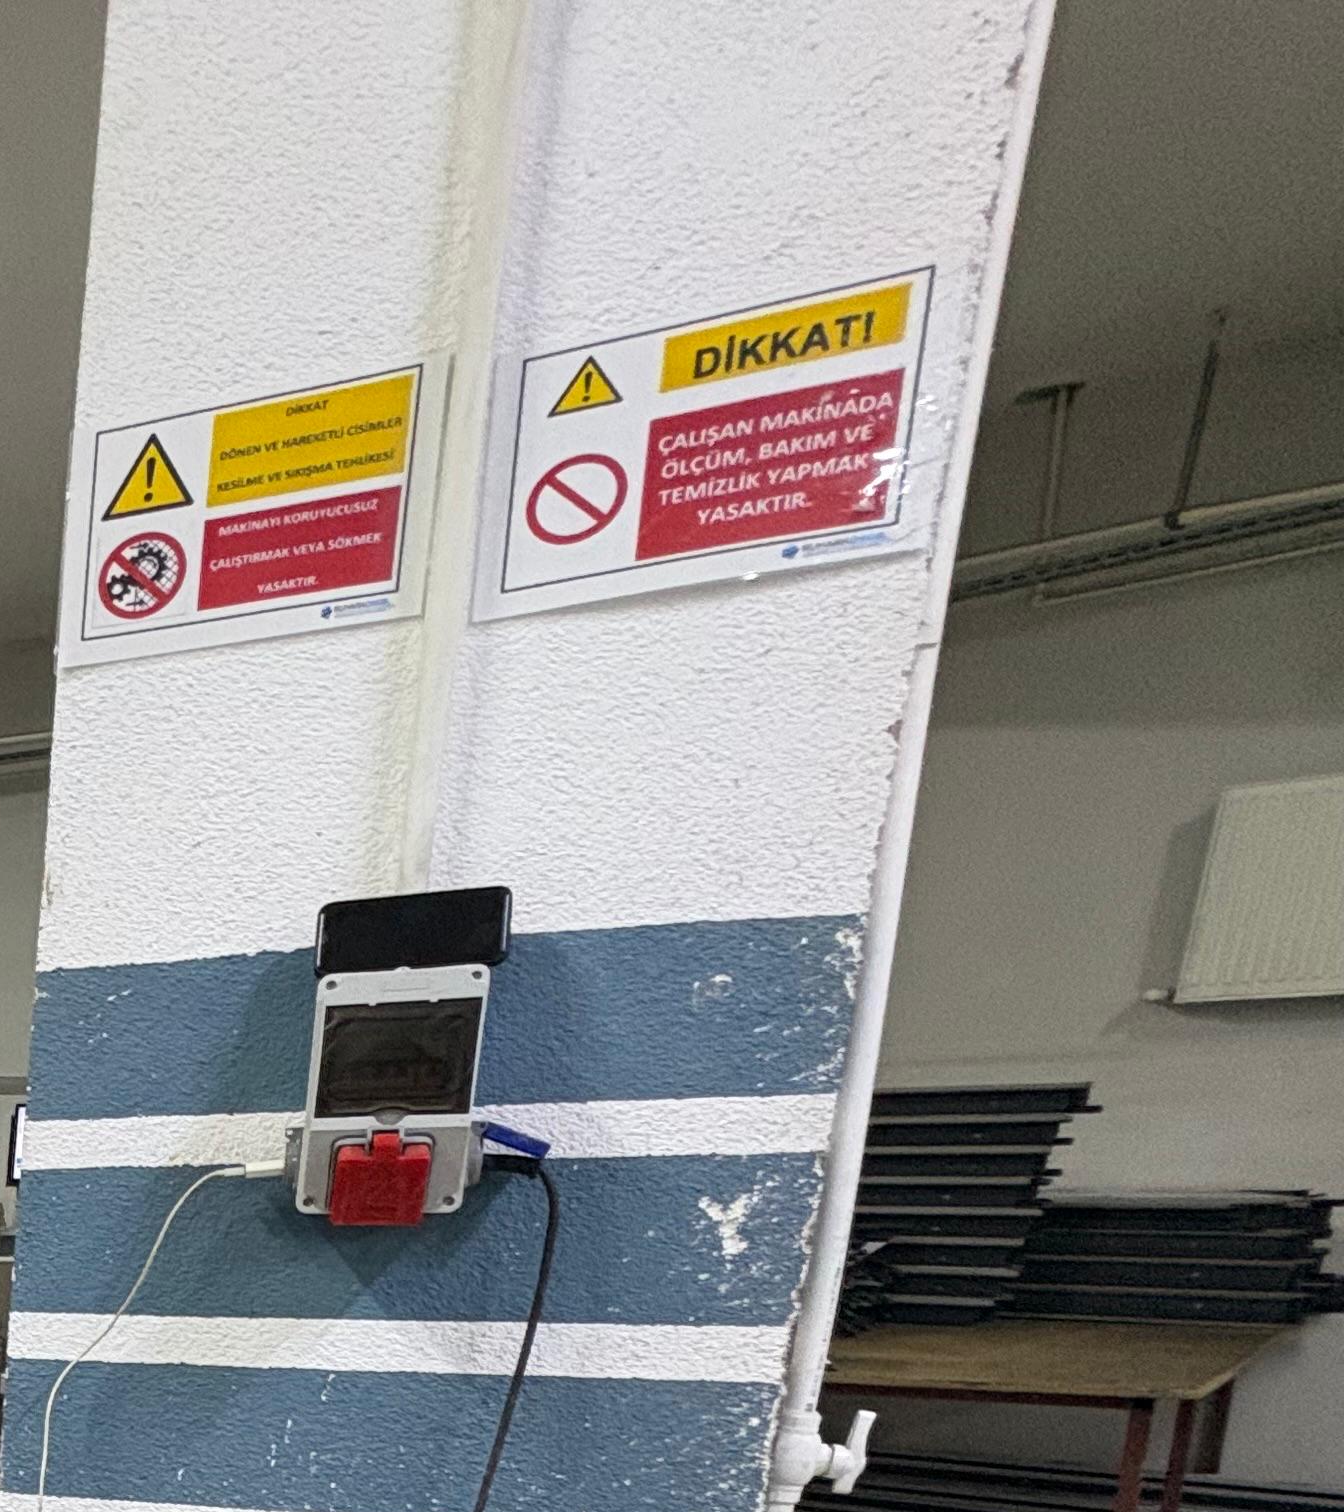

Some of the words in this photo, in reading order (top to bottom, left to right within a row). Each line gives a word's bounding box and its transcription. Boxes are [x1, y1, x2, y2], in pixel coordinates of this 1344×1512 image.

[693, 311, 876, 379] DİKKAT!
[285, 399, 330, 417] DİKKAT
[658, 418, 754, 454] ÇALIŞAN
[760, 391, 894, 431] MAKİNADA
[219, 444, 262, 460] DÖNEN
[264, 440, 280, 453] VE
[281, 426, 345, 449] HAREKETLİ
[346, 417, 403, 436] CİSİMLER
[661, 446, 753, 480] ÖLÇÜM,
[758, 430, 836, 457] BAKIM
[843, 423, 874, 445] VE
[216, 472, 265, 492] KESİLME
[267, 469, 282, 483] VE
[335, 447, 395, 470] TEHLİKESİ
[659, 471, 761, 506] TEMİZLİK
[766, 453, 870, 484] YAPMAK
[283, 499, 379, 526] KORUYUCUSUZ
[209, 549, 291, 572] ÇALIŞTIRMAK
[292, 541, 326, 556] VEYA
[326, 531, 383, 550] SÖKMEK
